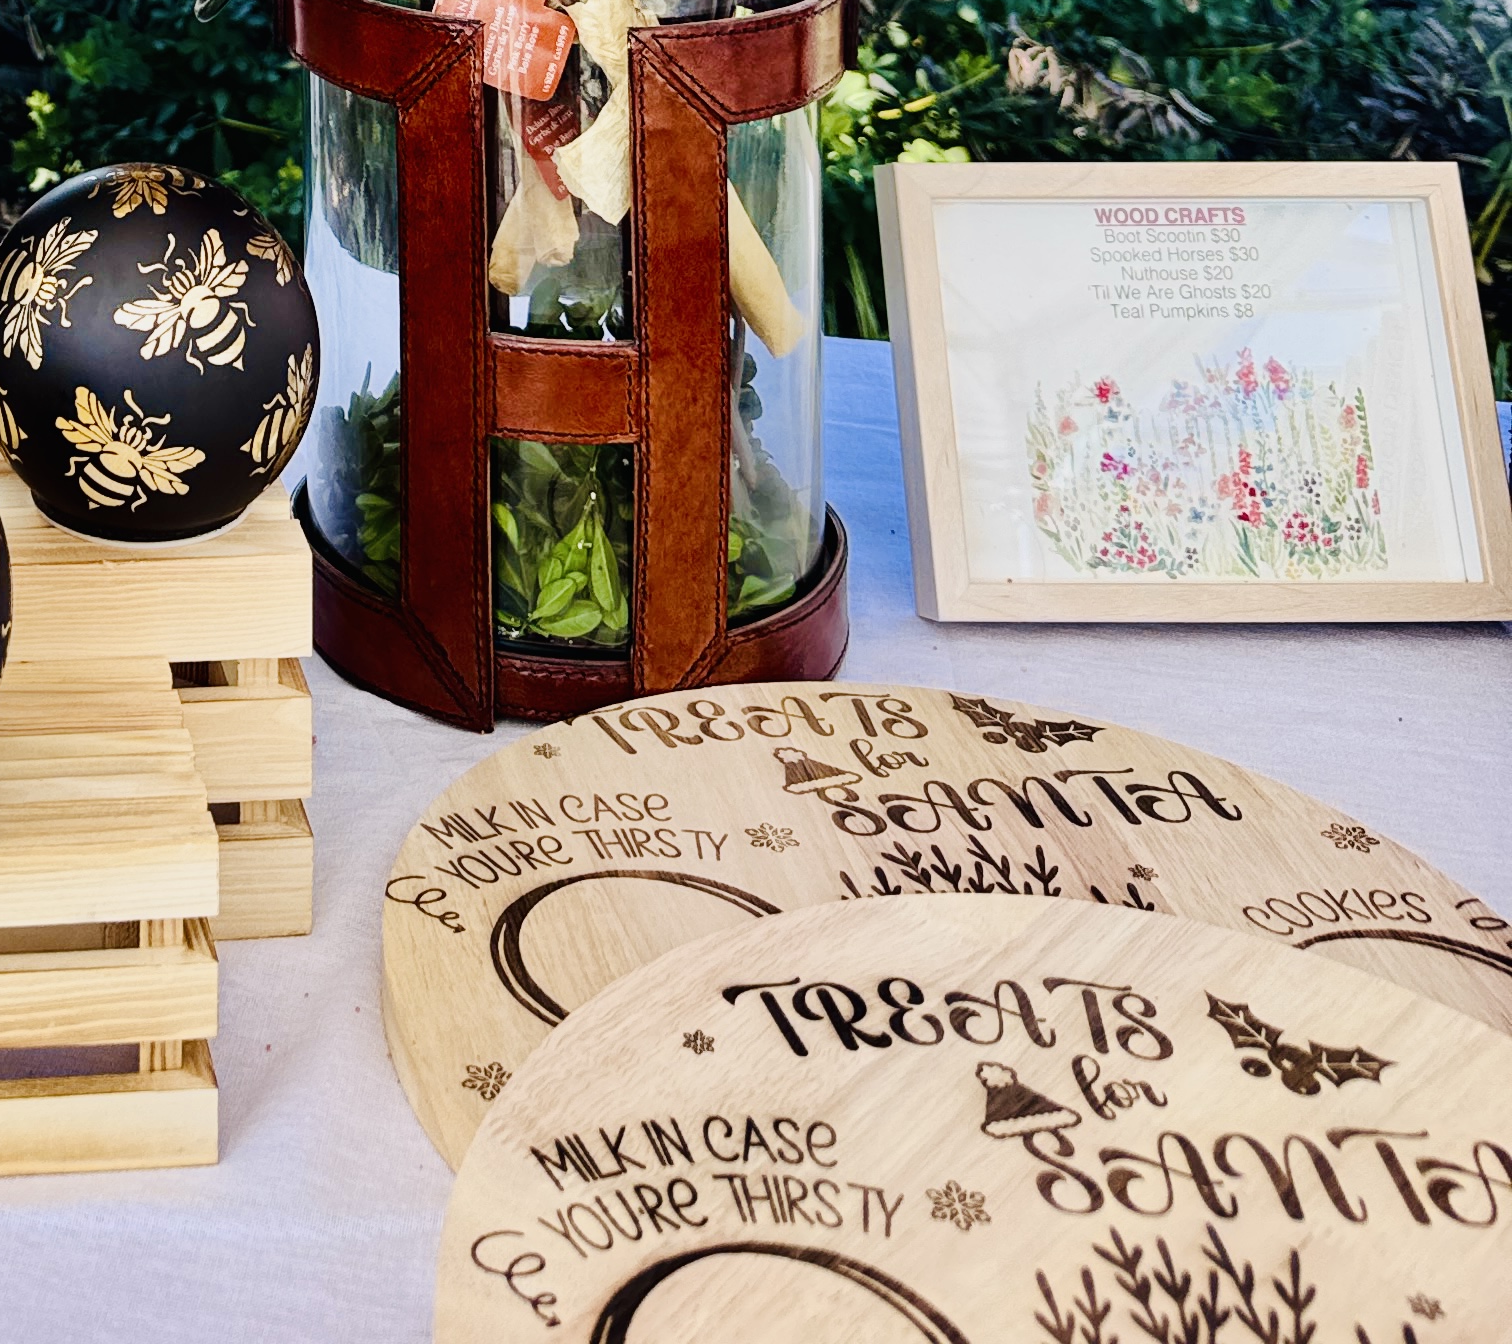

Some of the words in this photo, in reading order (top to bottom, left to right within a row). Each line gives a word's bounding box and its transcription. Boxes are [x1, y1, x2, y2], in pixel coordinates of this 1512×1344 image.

[513, 21, 531, 49] Berry
[524, 24, 540, 52] Rose
[1093, 207, 1159, 224] WOOD
[1164, 206, 1246, 224] CRAFTS
[1104, 228, 1142, 243] Boot
[1145, 228, 1206, 243] Scootin
[1210, 227, 1241, 244] $30
[1090, 247, 1162, 265] Spooked
[1167, 247, 1224, 262] Horses
[1228, 246, 1259, 262] $30
[1121, 266, 1199, 281] Nuthouse
[1202, 265, 1234, 281] $20
[1114, 284, 1141, 299] We
[1146, 284, 1174, 299] Are
[1178, 284, 1237, 300] Ghosts
[1240, 283, 1272, 300] $20
[1110, 303, 1145, 319] Teal
[1149, 303, 1230, 322] Pumpkins
[1233, 302, 1255, 319] $8
[567, 692, 929, 755] TREATS
[849, 737, 930, 779] for
[816, 767, 1243, 838] SANTA
[421, 804, 511, 850] MILK
[507, 798, 557, 830] IN
[721, 976, 1174, 1061] TREATS
[1071, 1054, 1169, 1120] for
[530, 1125, 646, 1191] MILK
[641, 1117, 695, 1166] IN
[1022, 1127, 1512, 1227] SANTA
